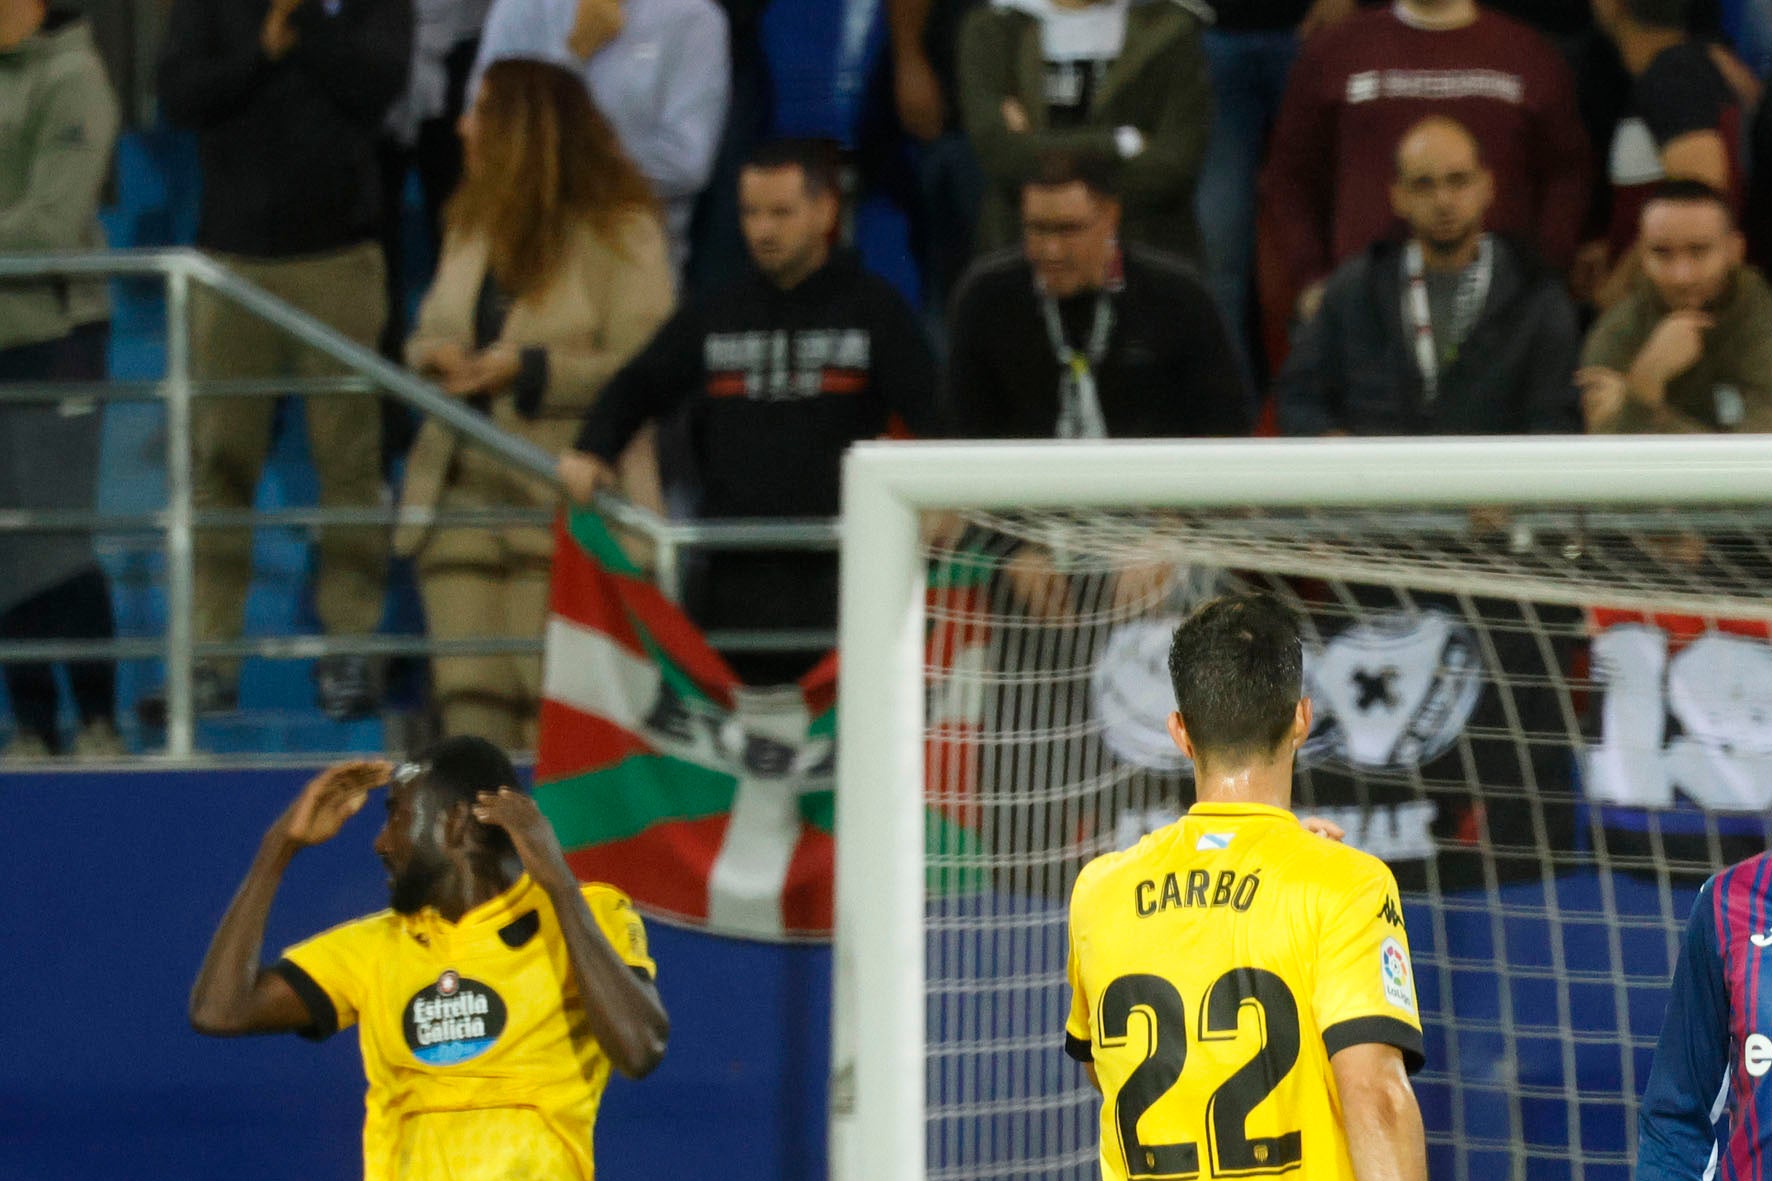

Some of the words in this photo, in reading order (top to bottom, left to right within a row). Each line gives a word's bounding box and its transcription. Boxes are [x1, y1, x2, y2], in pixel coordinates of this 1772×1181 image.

[1135, 867, 1262, 919] CARBÓ
[413, 990, 489, 1023] Estrella
[416, 1016, 486, 1046] Galicia
